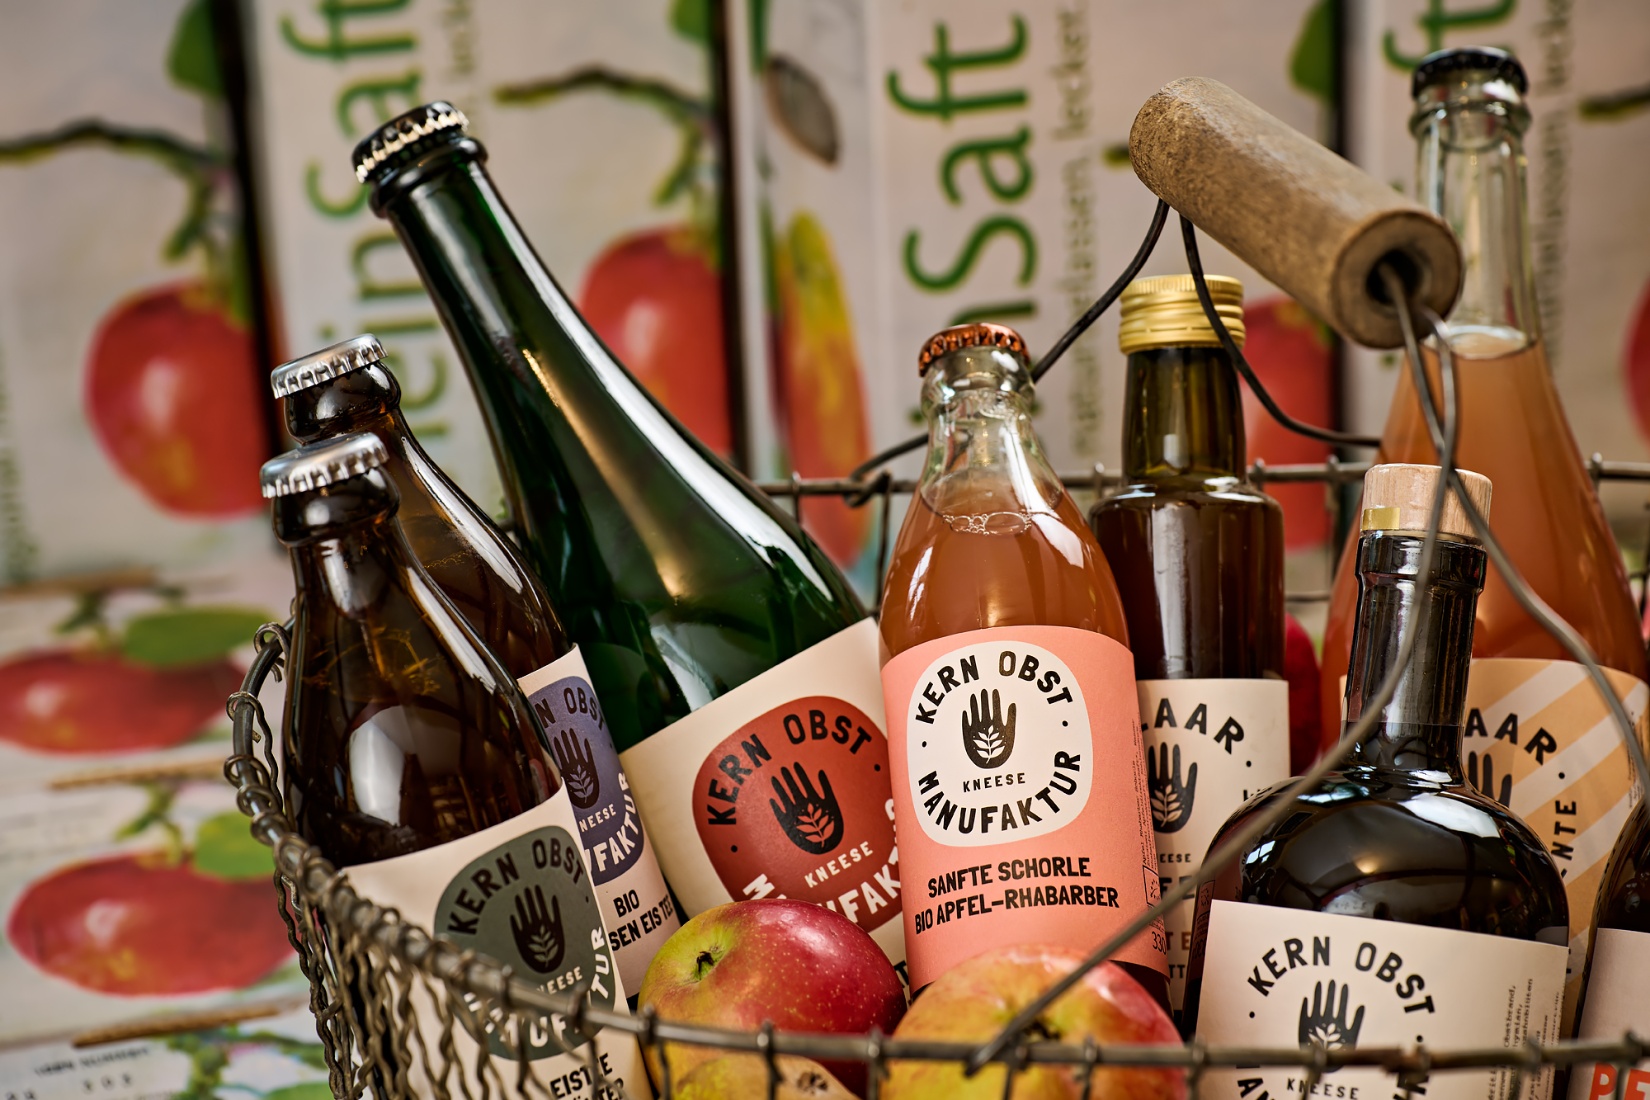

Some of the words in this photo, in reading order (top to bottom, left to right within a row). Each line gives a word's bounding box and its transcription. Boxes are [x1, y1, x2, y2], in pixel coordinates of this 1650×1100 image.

[564, 687, 605, 731] OBST
[915, 655, 980, 724] KERN
[998, 650, 1073, 705] OBST
[1141, 698, 1245, 755] AAR
[1464, 708, 1557, 766] AAR
[706, 733, 772, 825] KERN
[783, 709, 872, 755] OBST
[963, 772, 1026, 793] KNEESE
[918, 750, 1081, 834] MANUFAKTUR
[579, 804, 616, 832] NEESE
[447, 852, 520, 935] KERN
[532, 838, 584, 884] OBST
[804, 841, 873, 888] KNEESE
[928, 864, 993, 898] SANFTE
[998, 857, 1091, 882] SCHORLE
[613, 889, 639, 918] BIO
[915, 908, 933, 935] BIO
[608, 919, 641, 951] SEN
[1247, 936, 1330, 997] KERN
[1355, 942, 1435, 1014] OBST
[550, 1053, 613, 1098] EISTE
